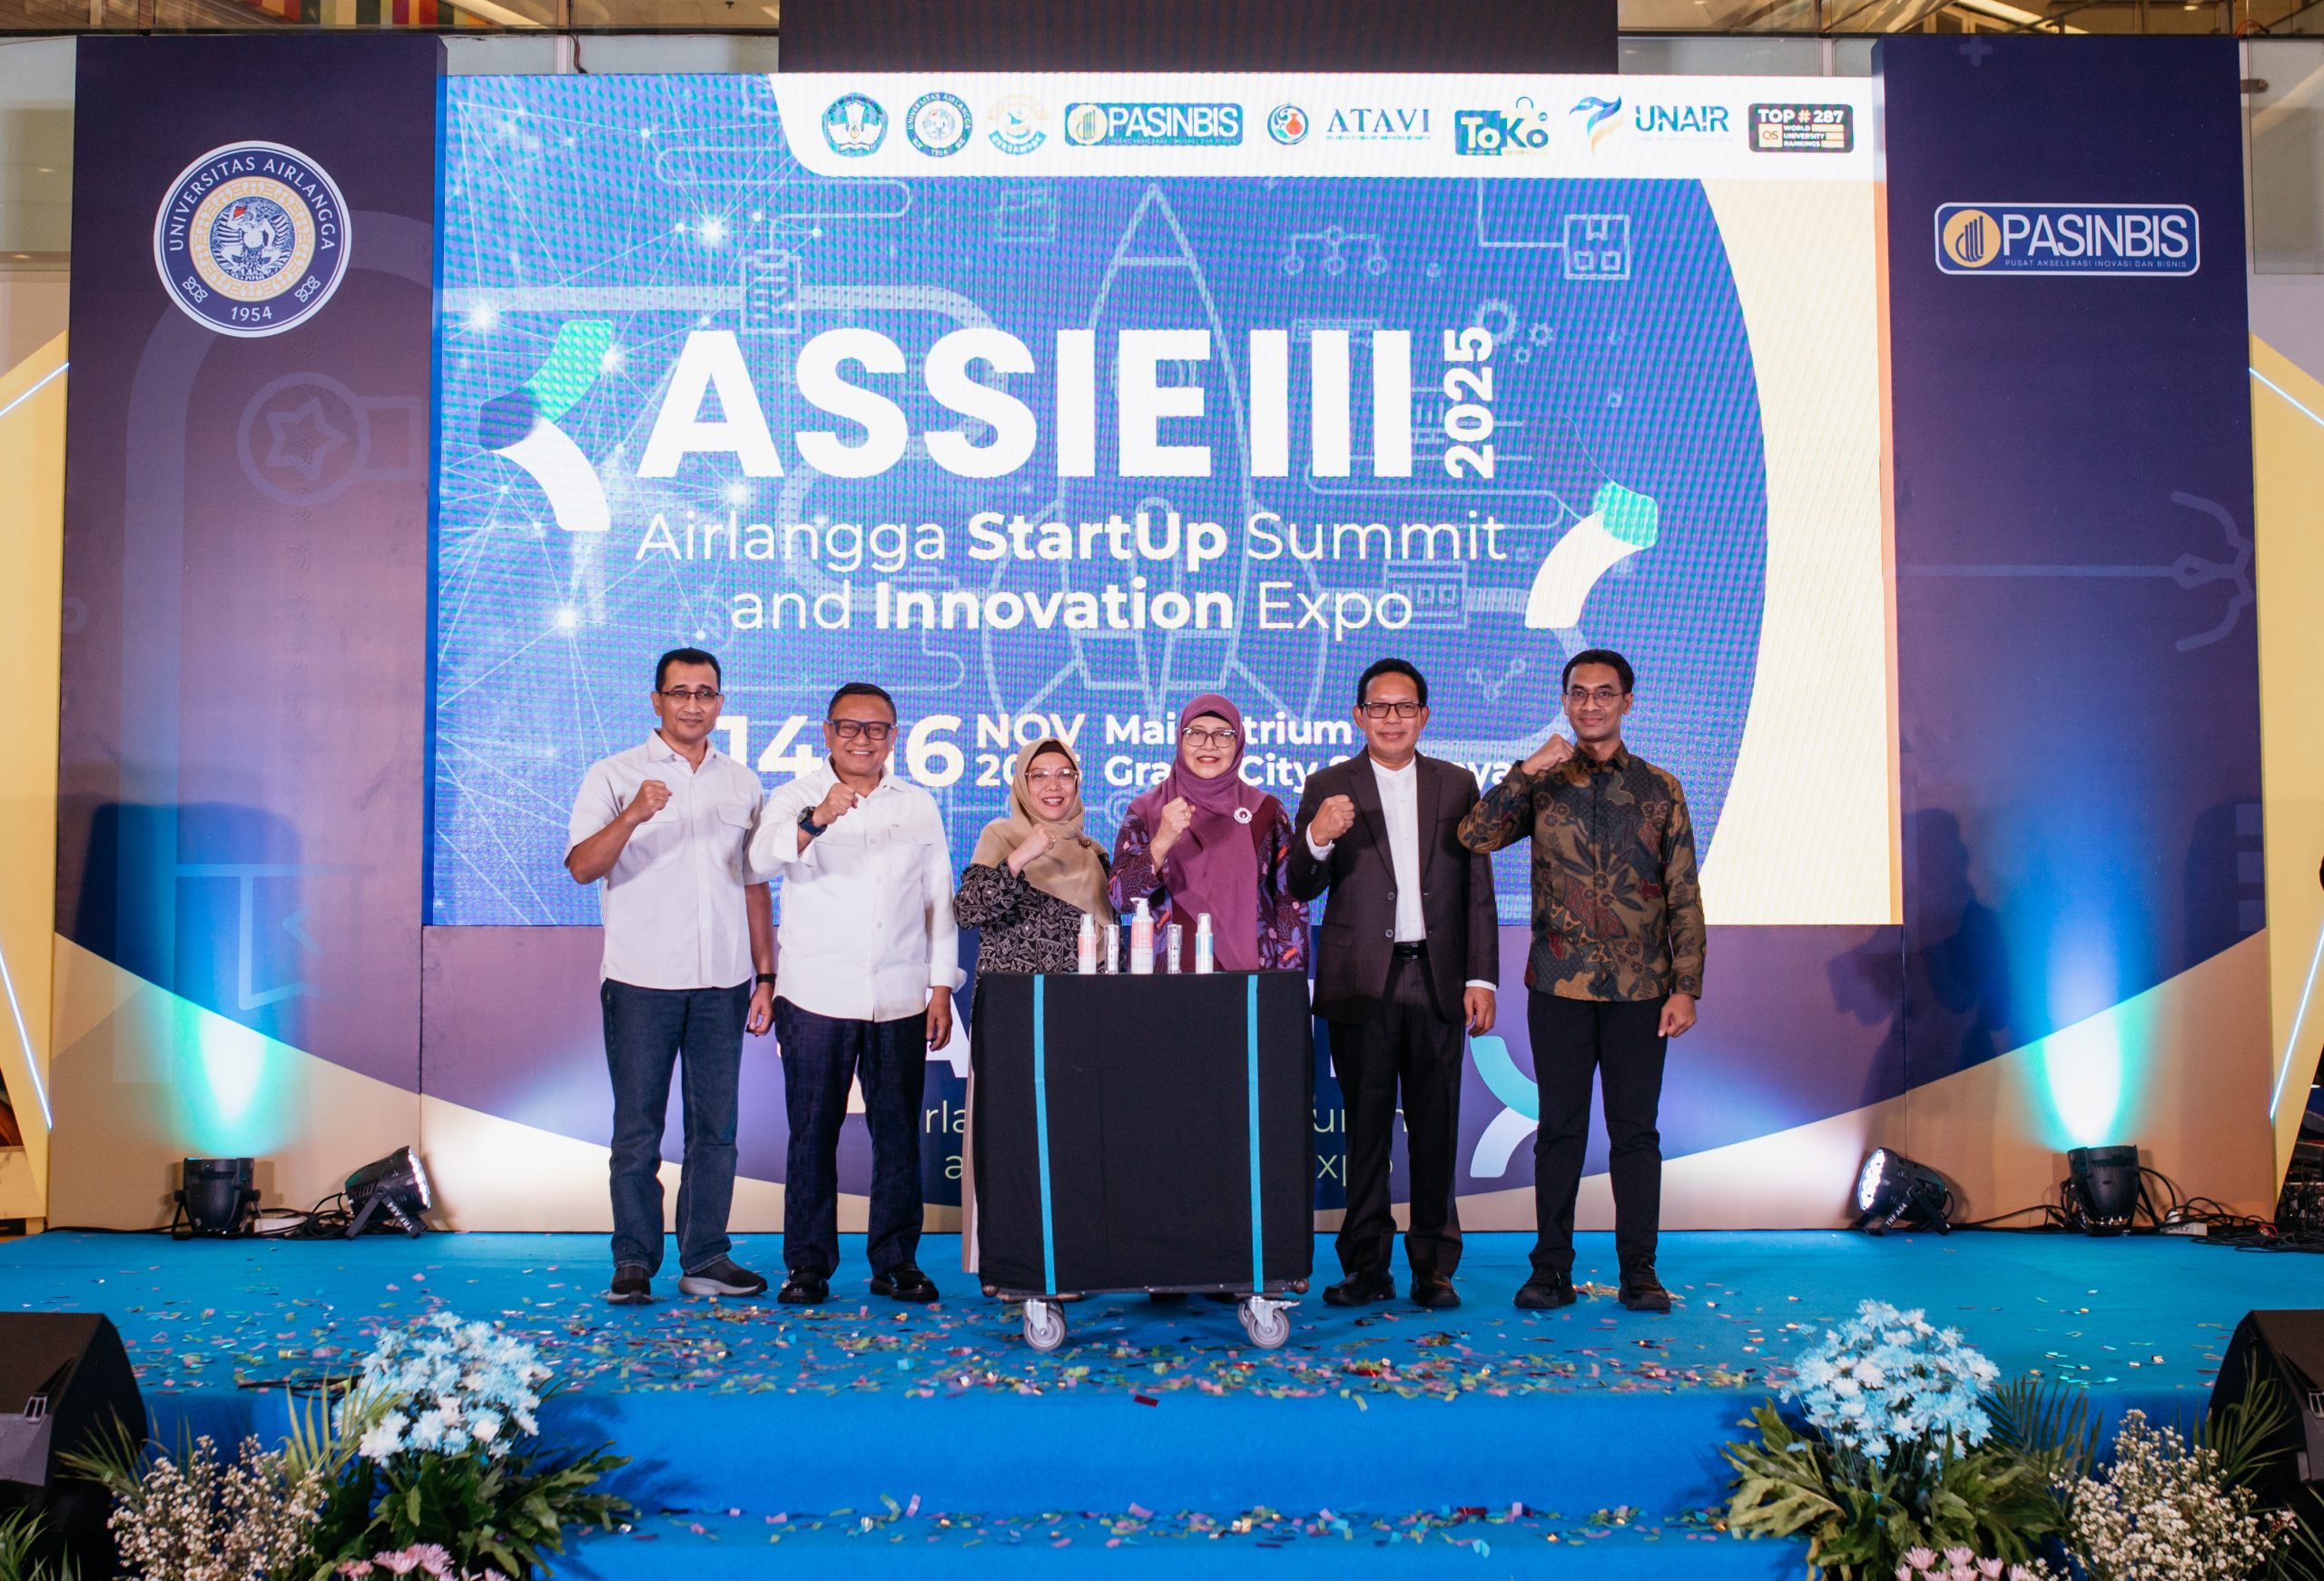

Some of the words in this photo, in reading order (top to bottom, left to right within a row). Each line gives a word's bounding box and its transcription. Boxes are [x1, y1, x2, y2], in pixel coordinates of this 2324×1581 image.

[1109, 106, 1238, 137] PASINBIS
[1326, 108, 1431, 133] ATAVI
[1635, 104, 1729, 133] UNAIR
[1758, 108, 1795, 124] TOP
[1813, 109, 1844, 124] 287
[1762, 130, 1779, 140] QS
[1783, 132, 1825, 140] UNIVERSITY
[1783, 140, 1821, 148] RANKINGS
[170, 156, 255, 252] UNIVERSITAS
[263, 158, 336, 251] AIRLANGGA
[2003, 213, 2190, 259] PASINBIS
[2004, 259, 2034, 267] PUSAT
[2037, 259, 2092, 267] AKSELERASI
[2094, 260, 2132, 268] INOVASI
[2134, 260, 2154, 268] DAN
[2156, 260, 2188, 268] BISNIS
[231, 305, 273, 322] 1954
[636, 328, 1211, 479] ASSIE
[1250, 330, 1413, 478] III
[1443, 327, 1493, 479] 2025
[635, 511, 946, 572] Airlangga
[967, 511, 1227, 572] StartUp
[1247, 511, 1507, 560] Summit
[731, 580, 852, 630] and
[876, 578, 1233, 629] Innovation
[1258, 582, 1413, 641] Expo
[977, 713, 1086, 748] NOV
[1106, 712, 1177, 745] Mai
[1240, 711, 1352, 745] trium
[1104, 755, 1174, 786] Gra
[1237, 753, 1313, 794] City
